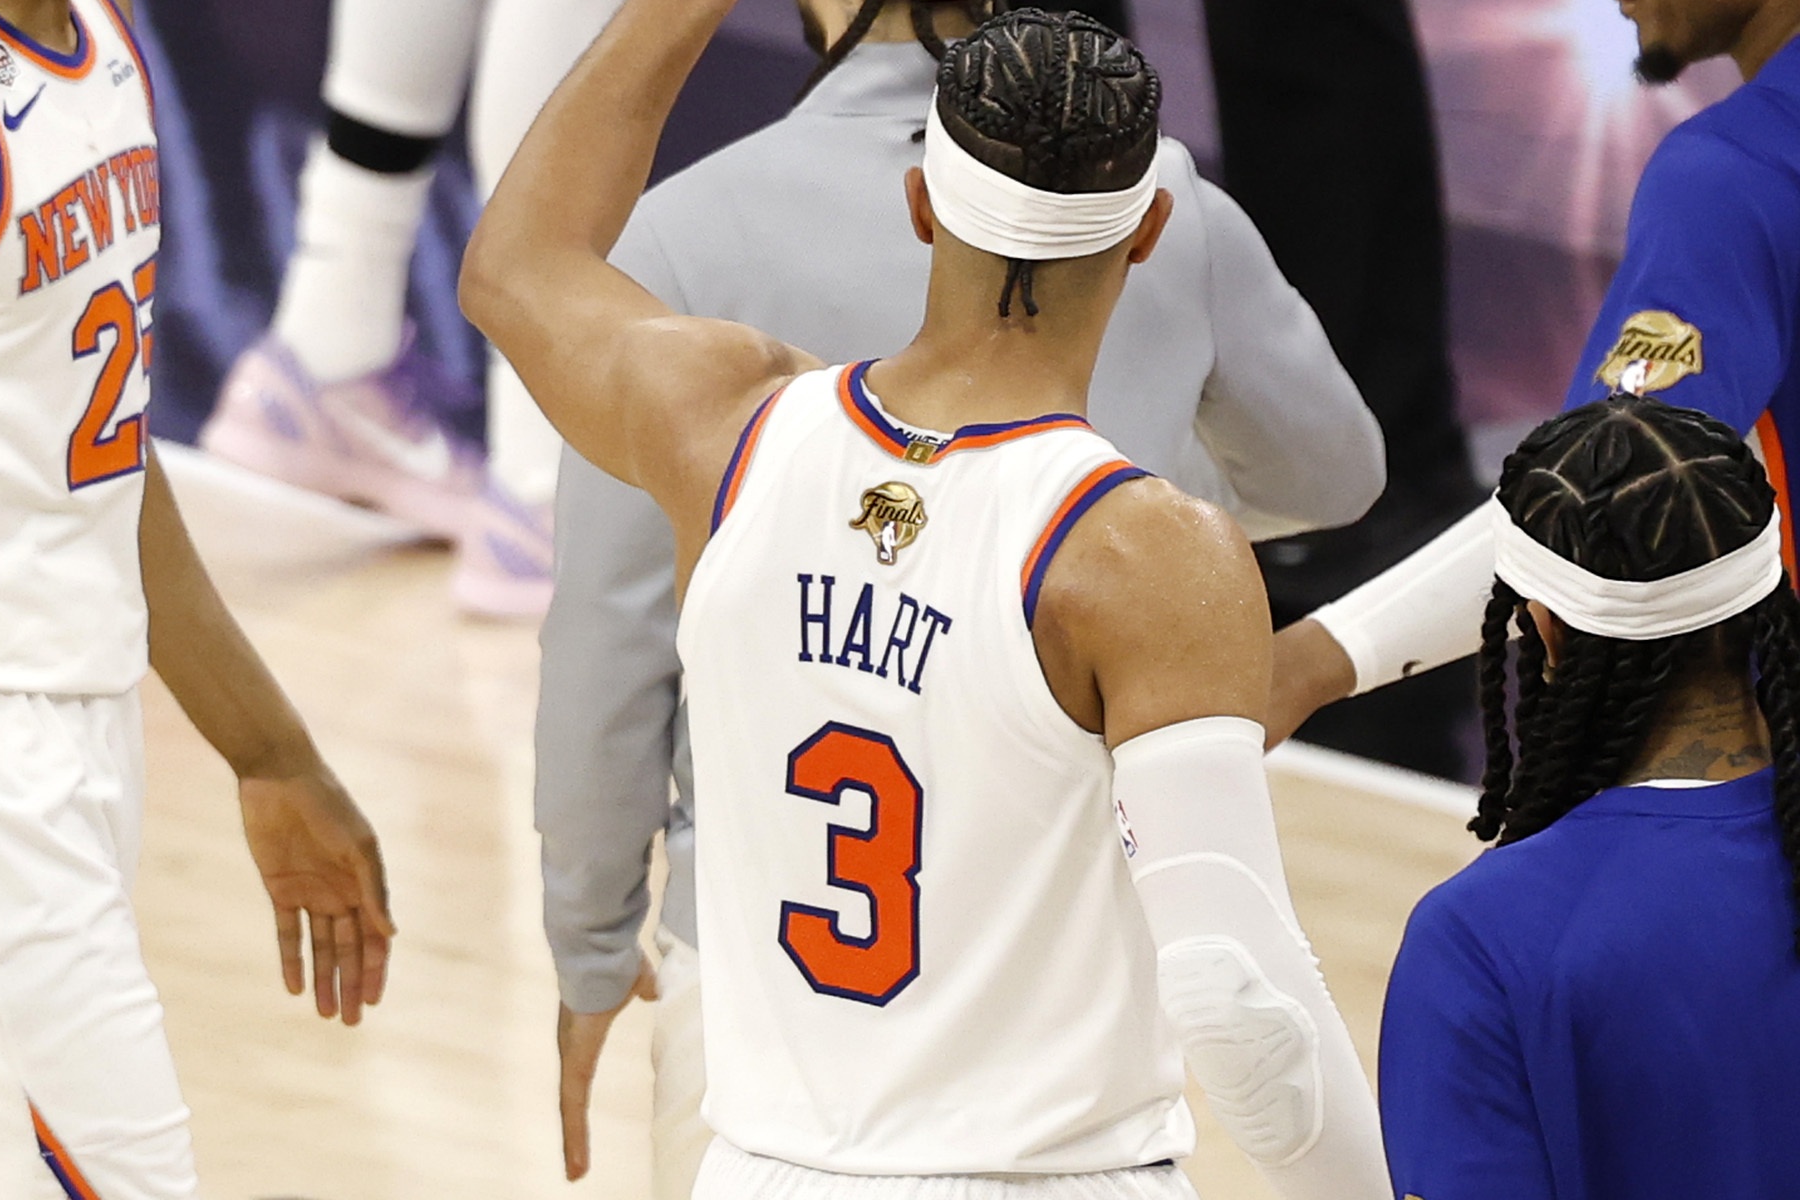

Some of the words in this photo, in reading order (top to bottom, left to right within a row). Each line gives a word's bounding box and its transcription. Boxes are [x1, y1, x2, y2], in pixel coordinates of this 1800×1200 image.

[18, 164, 113, 297] NEW
[849, 490, 925, 527] Finals
[797, 573, 953, 696] HART
[777, 720, 924, 1008] 3
